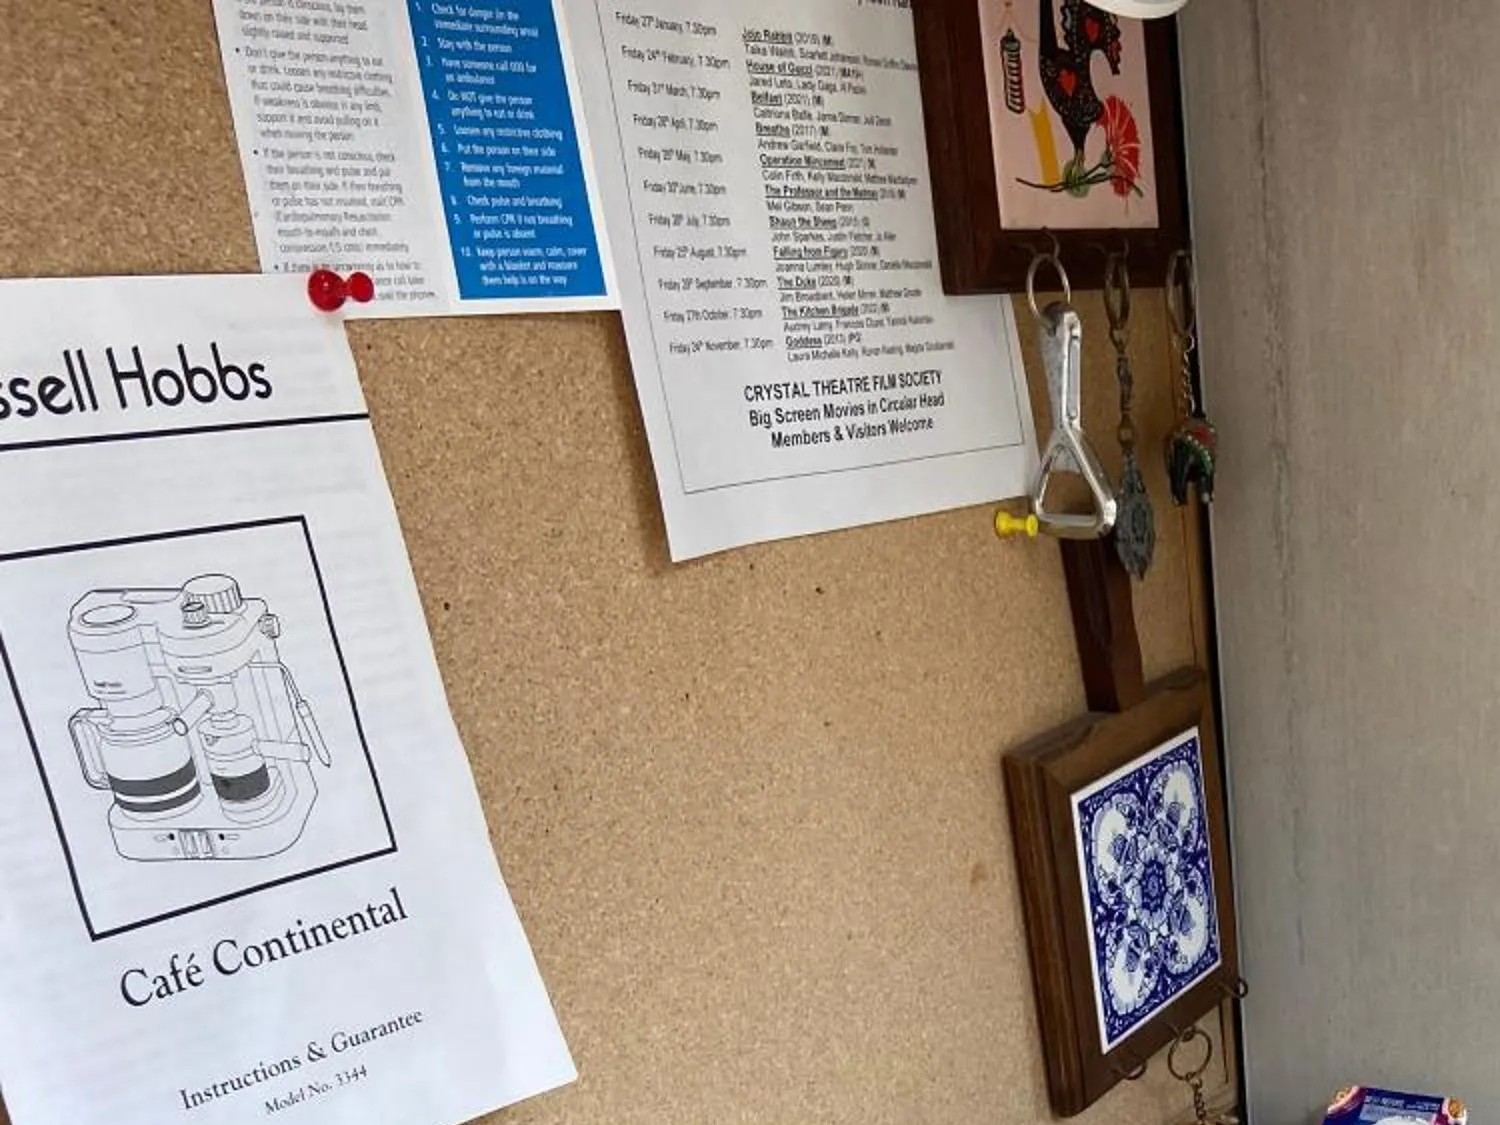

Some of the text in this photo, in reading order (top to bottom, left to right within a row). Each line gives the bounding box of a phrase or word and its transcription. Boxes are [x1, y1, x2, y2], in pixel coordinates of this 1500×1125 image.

[746, 59, 774, 74] House
[105, 342, 273, 409] Hobbs
[744, 369, 942, 402] CRYSTAL THEATRE FILM SOCIETY
[749, 390, 945, 429] Big Screen Movies in Circular Head
[771, 416, 934, 448] Members & Visitors Welcome
[120, 886, 409, 1007] Café Continental
[179, 1009, 424, 1110] Instructions & Guarantee
[264, 1087, 306, 1115] Model
[307, 1080, 334, 1099] No.
